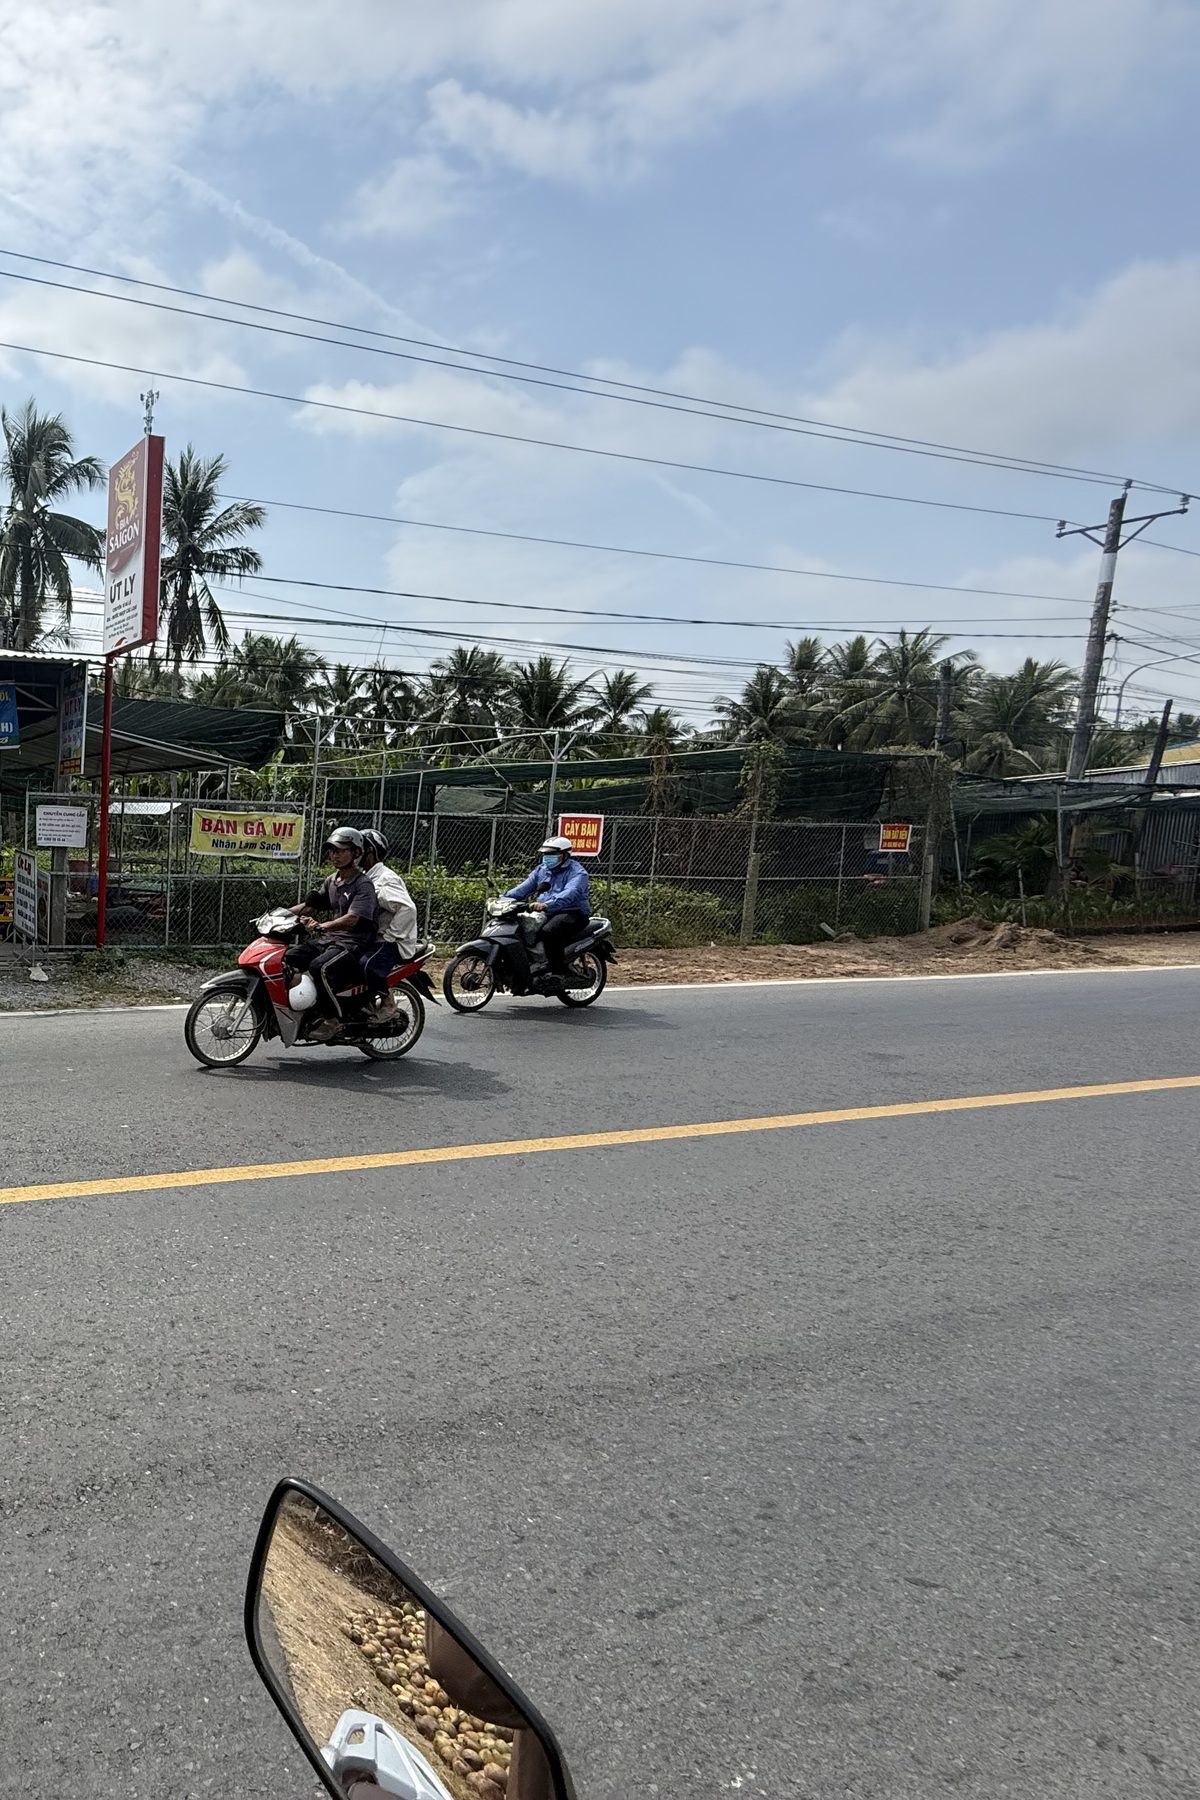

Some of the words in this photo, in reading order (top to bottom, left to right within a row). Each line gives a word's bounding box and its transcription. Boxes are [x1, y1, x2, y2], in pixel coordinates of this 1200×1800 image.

[109, 519, 140, 553] SAIGON
[110, 578, 123, 604] ÚT
[124, 573, 136, 597] LY
[200, 815, 238, 835] BÁN
[243, 819, 267, 837] GÀ
[272, 821, 296, 840] VỊT
[259, 840, 282, 852] Sạch
